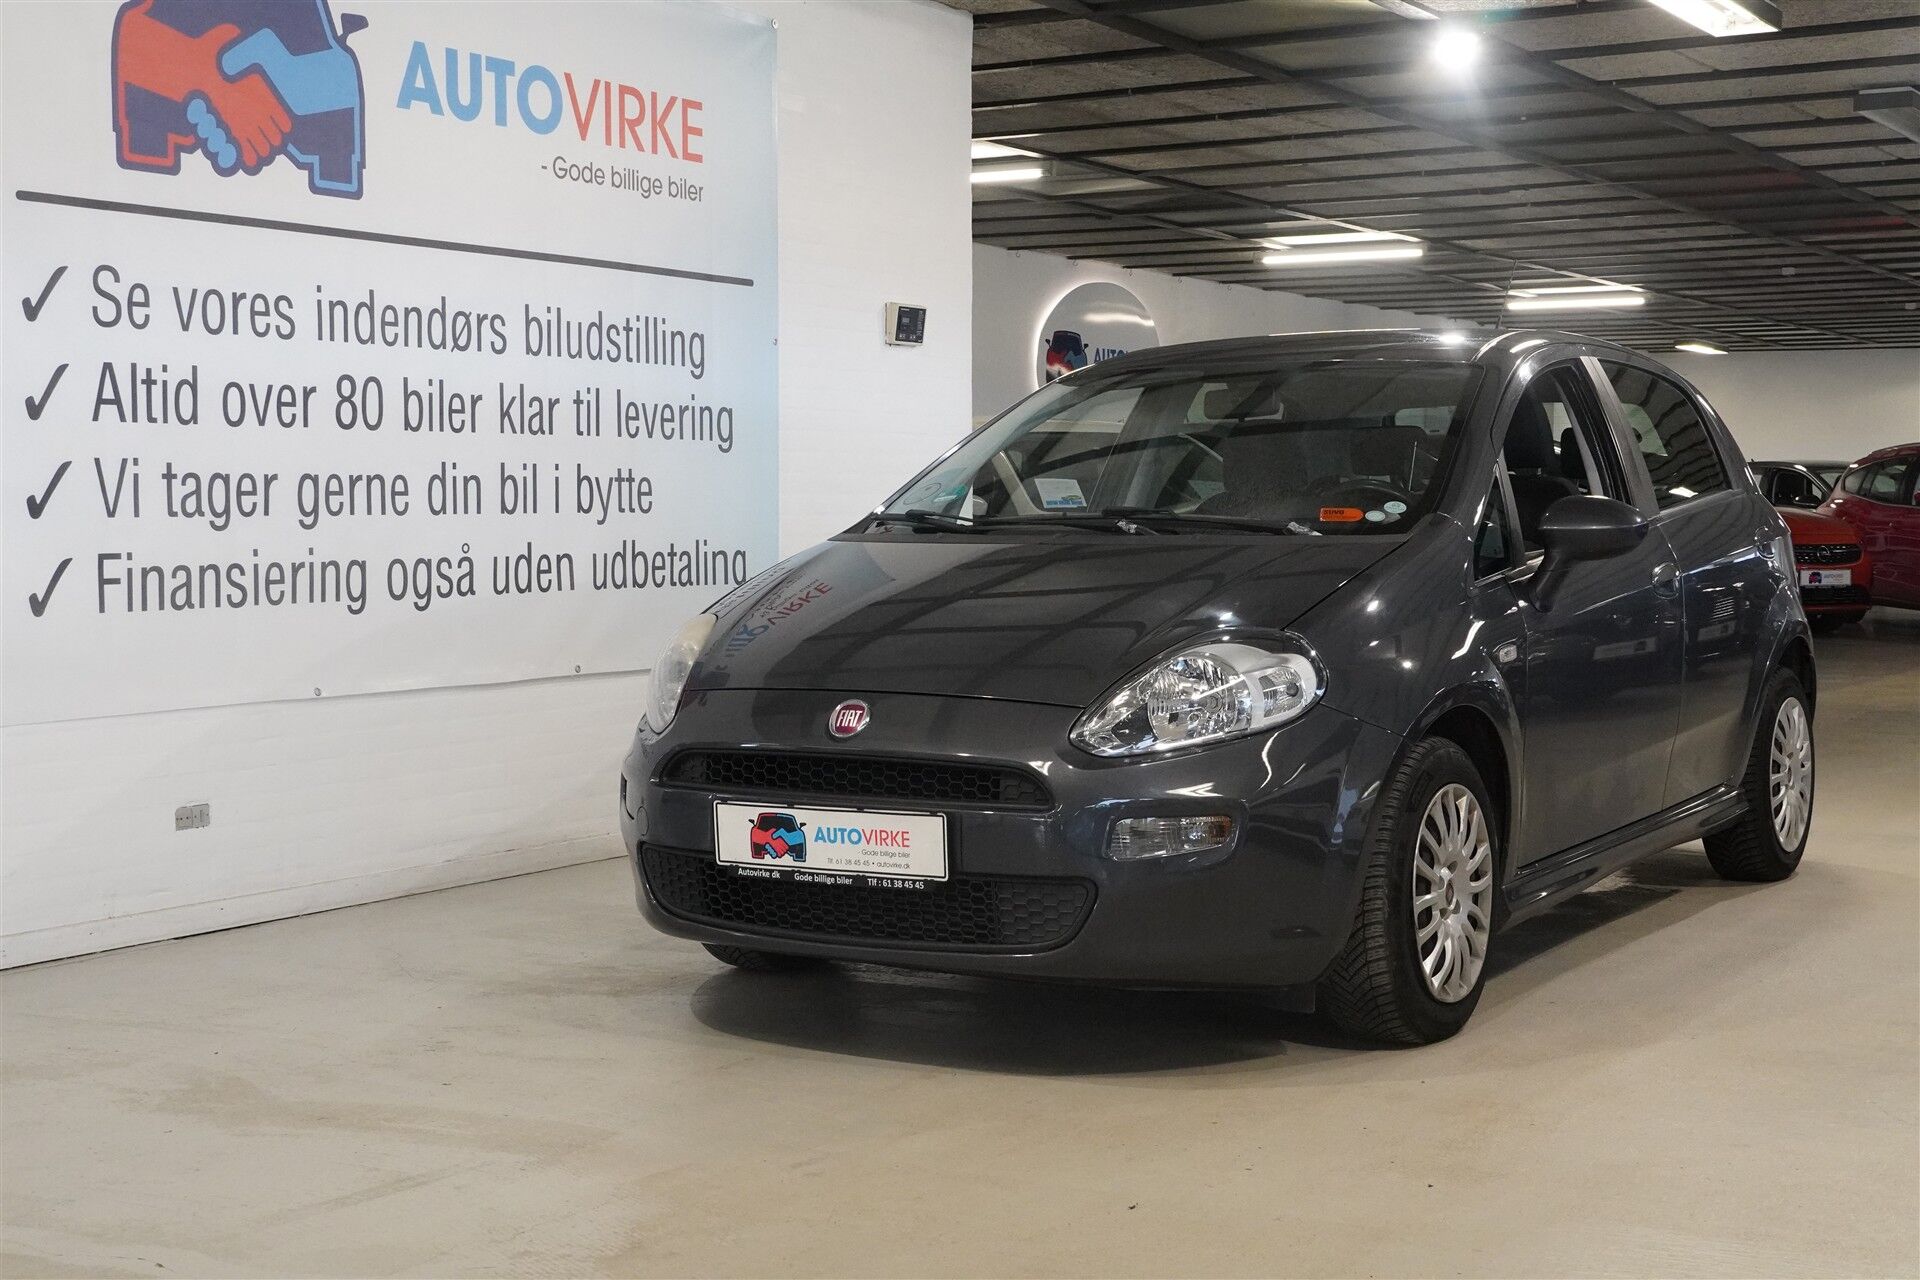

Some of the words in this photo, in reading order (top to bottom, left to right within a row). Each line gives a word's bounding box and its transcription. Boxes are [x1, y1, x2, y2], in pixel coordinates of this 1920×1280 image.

[396, 40, 704, 164] AUTOVIRKE
[552, 156, 606, 186] Gode
[610, 165, 663, 199] billige
[667, 175, 704, 202] biler
[91, 264, 151, 330] Se
[171, 286, 296, 340] vores
[315, 284, 508, 355] indendørs
[524, 303, 706, 380] biludstilling
[91, 361, 199, 426] Altid
[221, 380, 317, 429] over
[334, 373, 384, 431] 80
[402, 376, 483, 434] biler
[499, 382, 560, 436] klar
[572, 386, 601, 437] til
[616, 388, 734, 454] levering
[93, 457, 141, 519] Vi
[161, 462, 279, 532] tager
[297, 472, 410, 530] gerne
[427, 461, 482, 516] din
[500, 462, 538, 515] bil
[554, 463, 560, 514] i
[576, 463, 654, 526] bytte
[97, 547, 367, 616] Finansiering
[386, 542, 477, 612] også
[492, 541, 576, 596] uden
[592, 539, 747, 592] udbetaling
[836, 709, 864, 727] FIAT
[813, 826, 911, 848] AUTOVIRKE
[861, 848, 879, 857] Gode
[879, 850, 896, 859] billige
[738, 868, 770, 878] Autovirke
[772, 871, 781, 879] dk
[794, 872, 813, 882] Gode
[814, 874, 835, 885] billige
[836, 876, 853, 885] biler
[882, 879, 892, 888] 61
[893, 880, 903, 888] 38
[904, 881, 914, 889] 45
[915, 881, 925, 890] 45
[835, 858, 843, 866] 61
[853, 859, 862, 867] 45
[862, 860, 871, 868] 45
